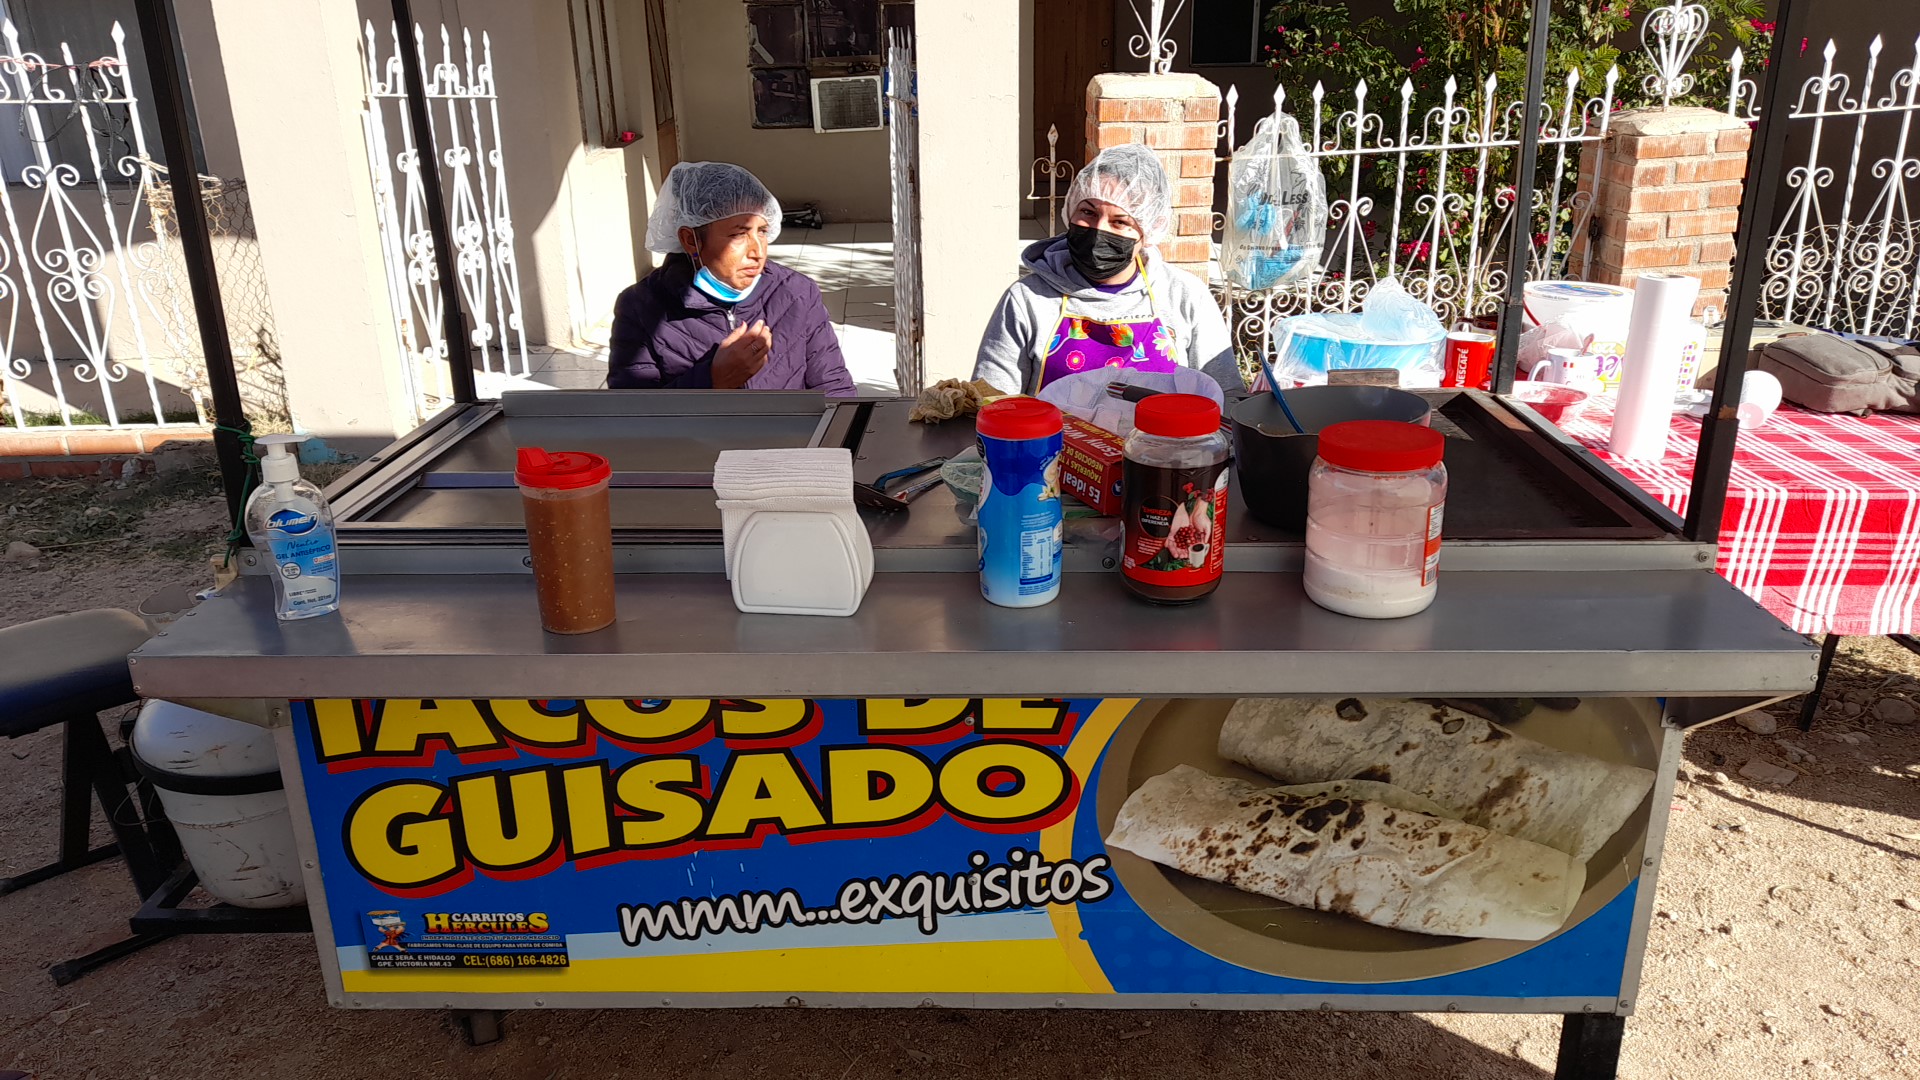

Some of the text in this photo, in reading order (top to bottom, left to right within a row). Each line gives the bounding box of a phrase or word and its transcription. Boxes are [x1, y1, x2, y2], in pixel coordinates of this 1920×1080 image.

[1281, 190, 1309, 206] LESS
[1455, 347, 1469, 388] NESCAFÉ
[1066, 445, 1074, 456] DE
[1065, 458, 1070, 466] Y
[1074, 450, 1104, 472] NEGOCIOS
[1062, 470, 1087, 496] ideal
[1088, 485, 1101, 504] Es
[266, 514, 318, 529] blumen
[341, 738, 1073, 888] GUISADO
[424, 911, 549, 934] HERCULES
[451, 912, 525, 922] CARRITOS
[463, 954, 567, 968] CEL:(686) 166-4826
